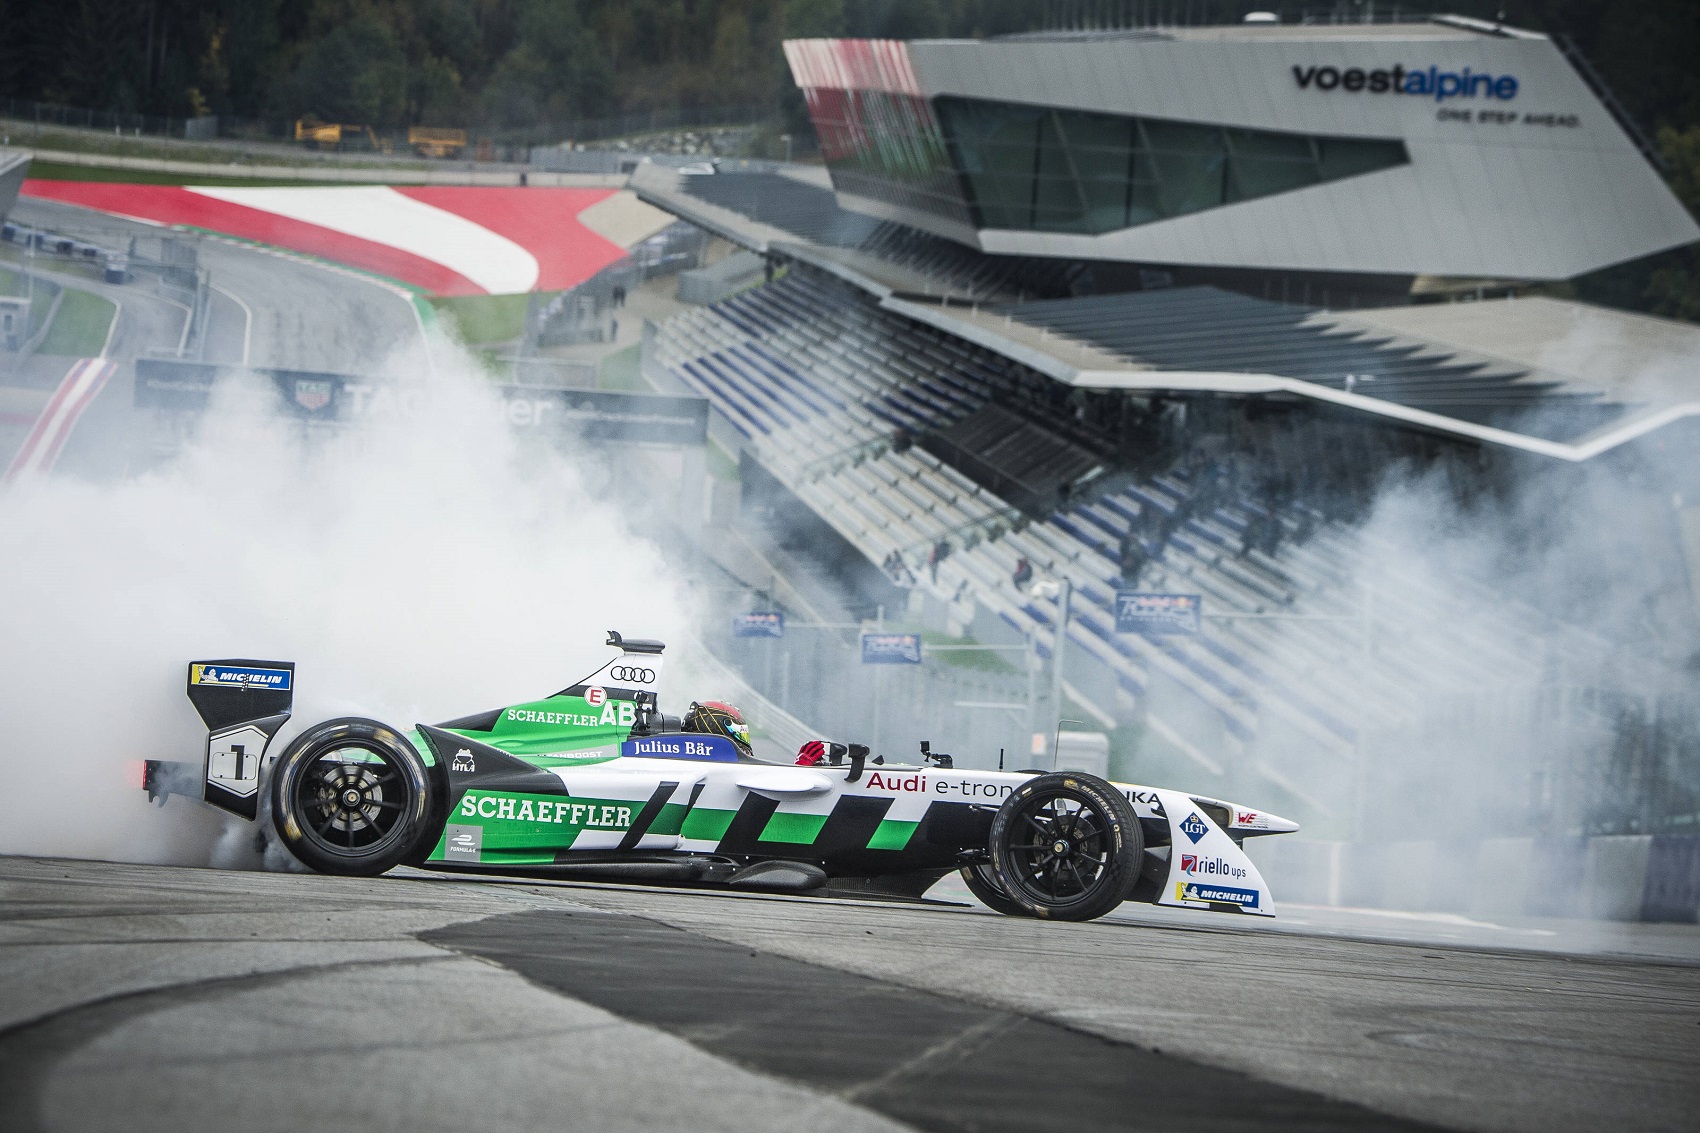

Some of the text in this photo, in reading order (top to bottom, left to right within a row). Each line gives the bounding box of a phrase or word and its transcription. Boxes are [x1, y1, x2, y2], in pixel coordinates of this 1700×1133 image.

[1292, 64, 1518, 102] voestalpine
[507, 709, 599, 727] SCHAEFFLER
[634, 741, 713, 756] Julius Bär
[231, 745, 245, 780] 1
[866, 772, 1013, 797] Audi e-tron
[461, 796, 631, 827] SCHAEFFLER
[1185, 823, 1206, 835] LGT
[1198, 857, 1247, 880] riello ups
[1201, 889, 1254, 903] MICHELIN
